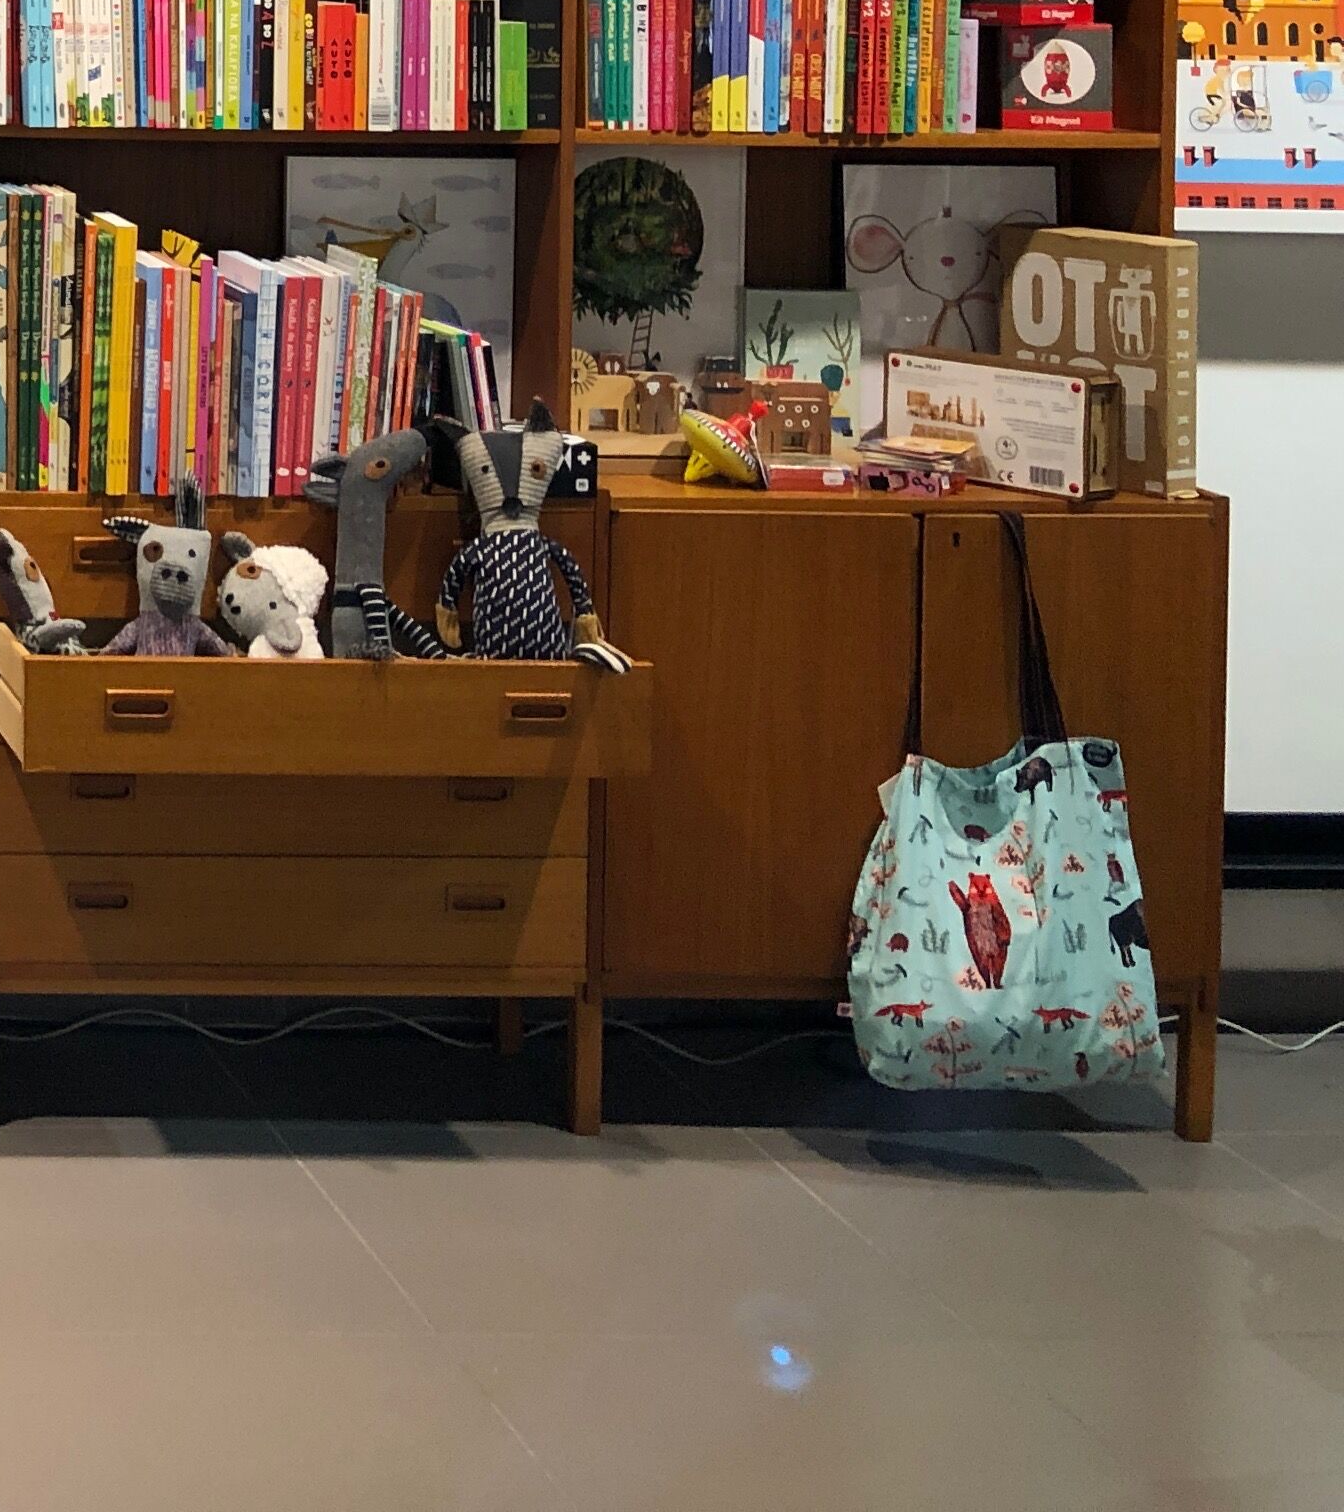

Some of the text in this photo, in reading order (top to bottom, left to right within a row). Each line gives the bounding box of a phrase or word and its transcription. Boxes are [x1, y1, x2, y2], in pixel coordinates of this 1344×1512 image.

[229, 13, 238, 29] NA
[262, 11, 273, 20] A
[263, 24, 272, 38] DO
[261, 41, 273, 50] Z
[330, 39, 338, 79] AUTO
[343, 39, 352, 78] AUTO
[228, 34, 238, 102] KALAFIORA
[1030, 115, 1081, 127] Kit Magnet
[1175, 266, 1190, 465] ANDRZEJ KOT
